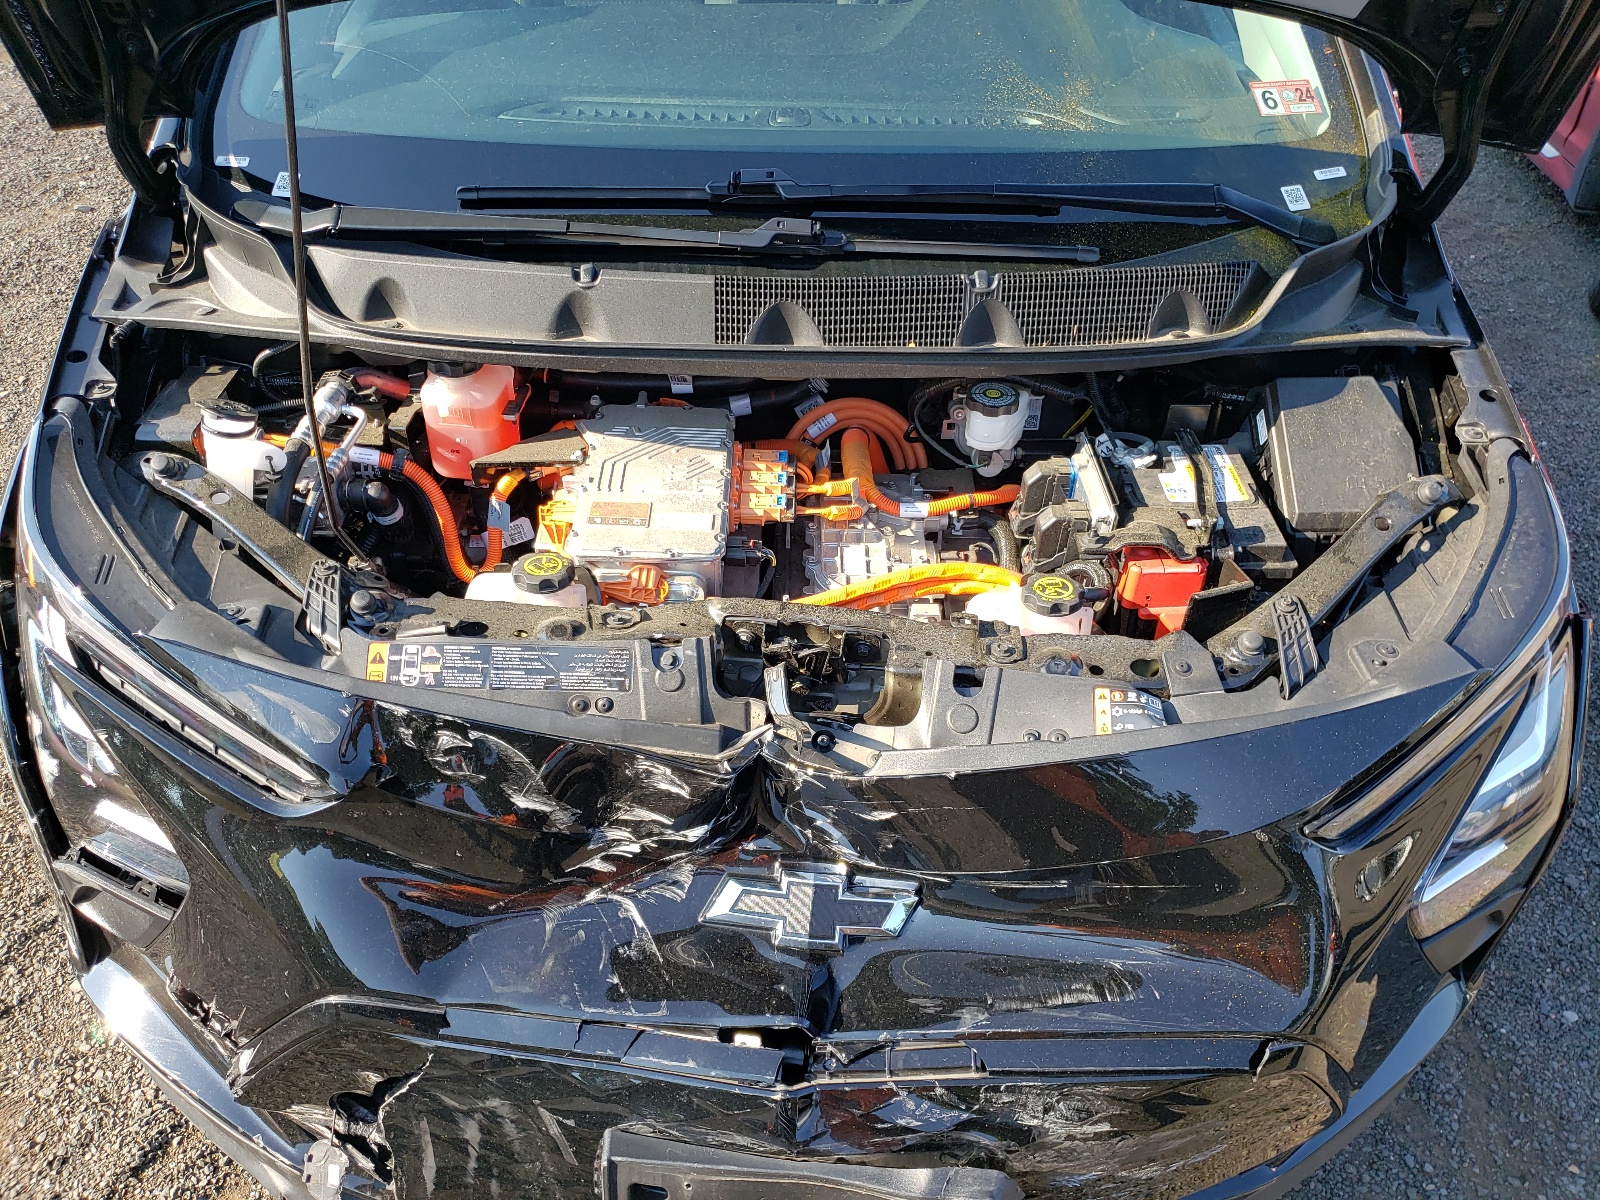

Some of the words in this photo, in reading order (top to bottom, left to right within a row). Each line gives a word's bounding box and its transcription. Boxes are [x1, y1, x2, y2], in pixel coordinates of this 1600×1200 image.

[1261, 90, 1278, 110] 6
[1294, 87, 1315, 102] 24
[1101, 445, 1113, 456] 14
